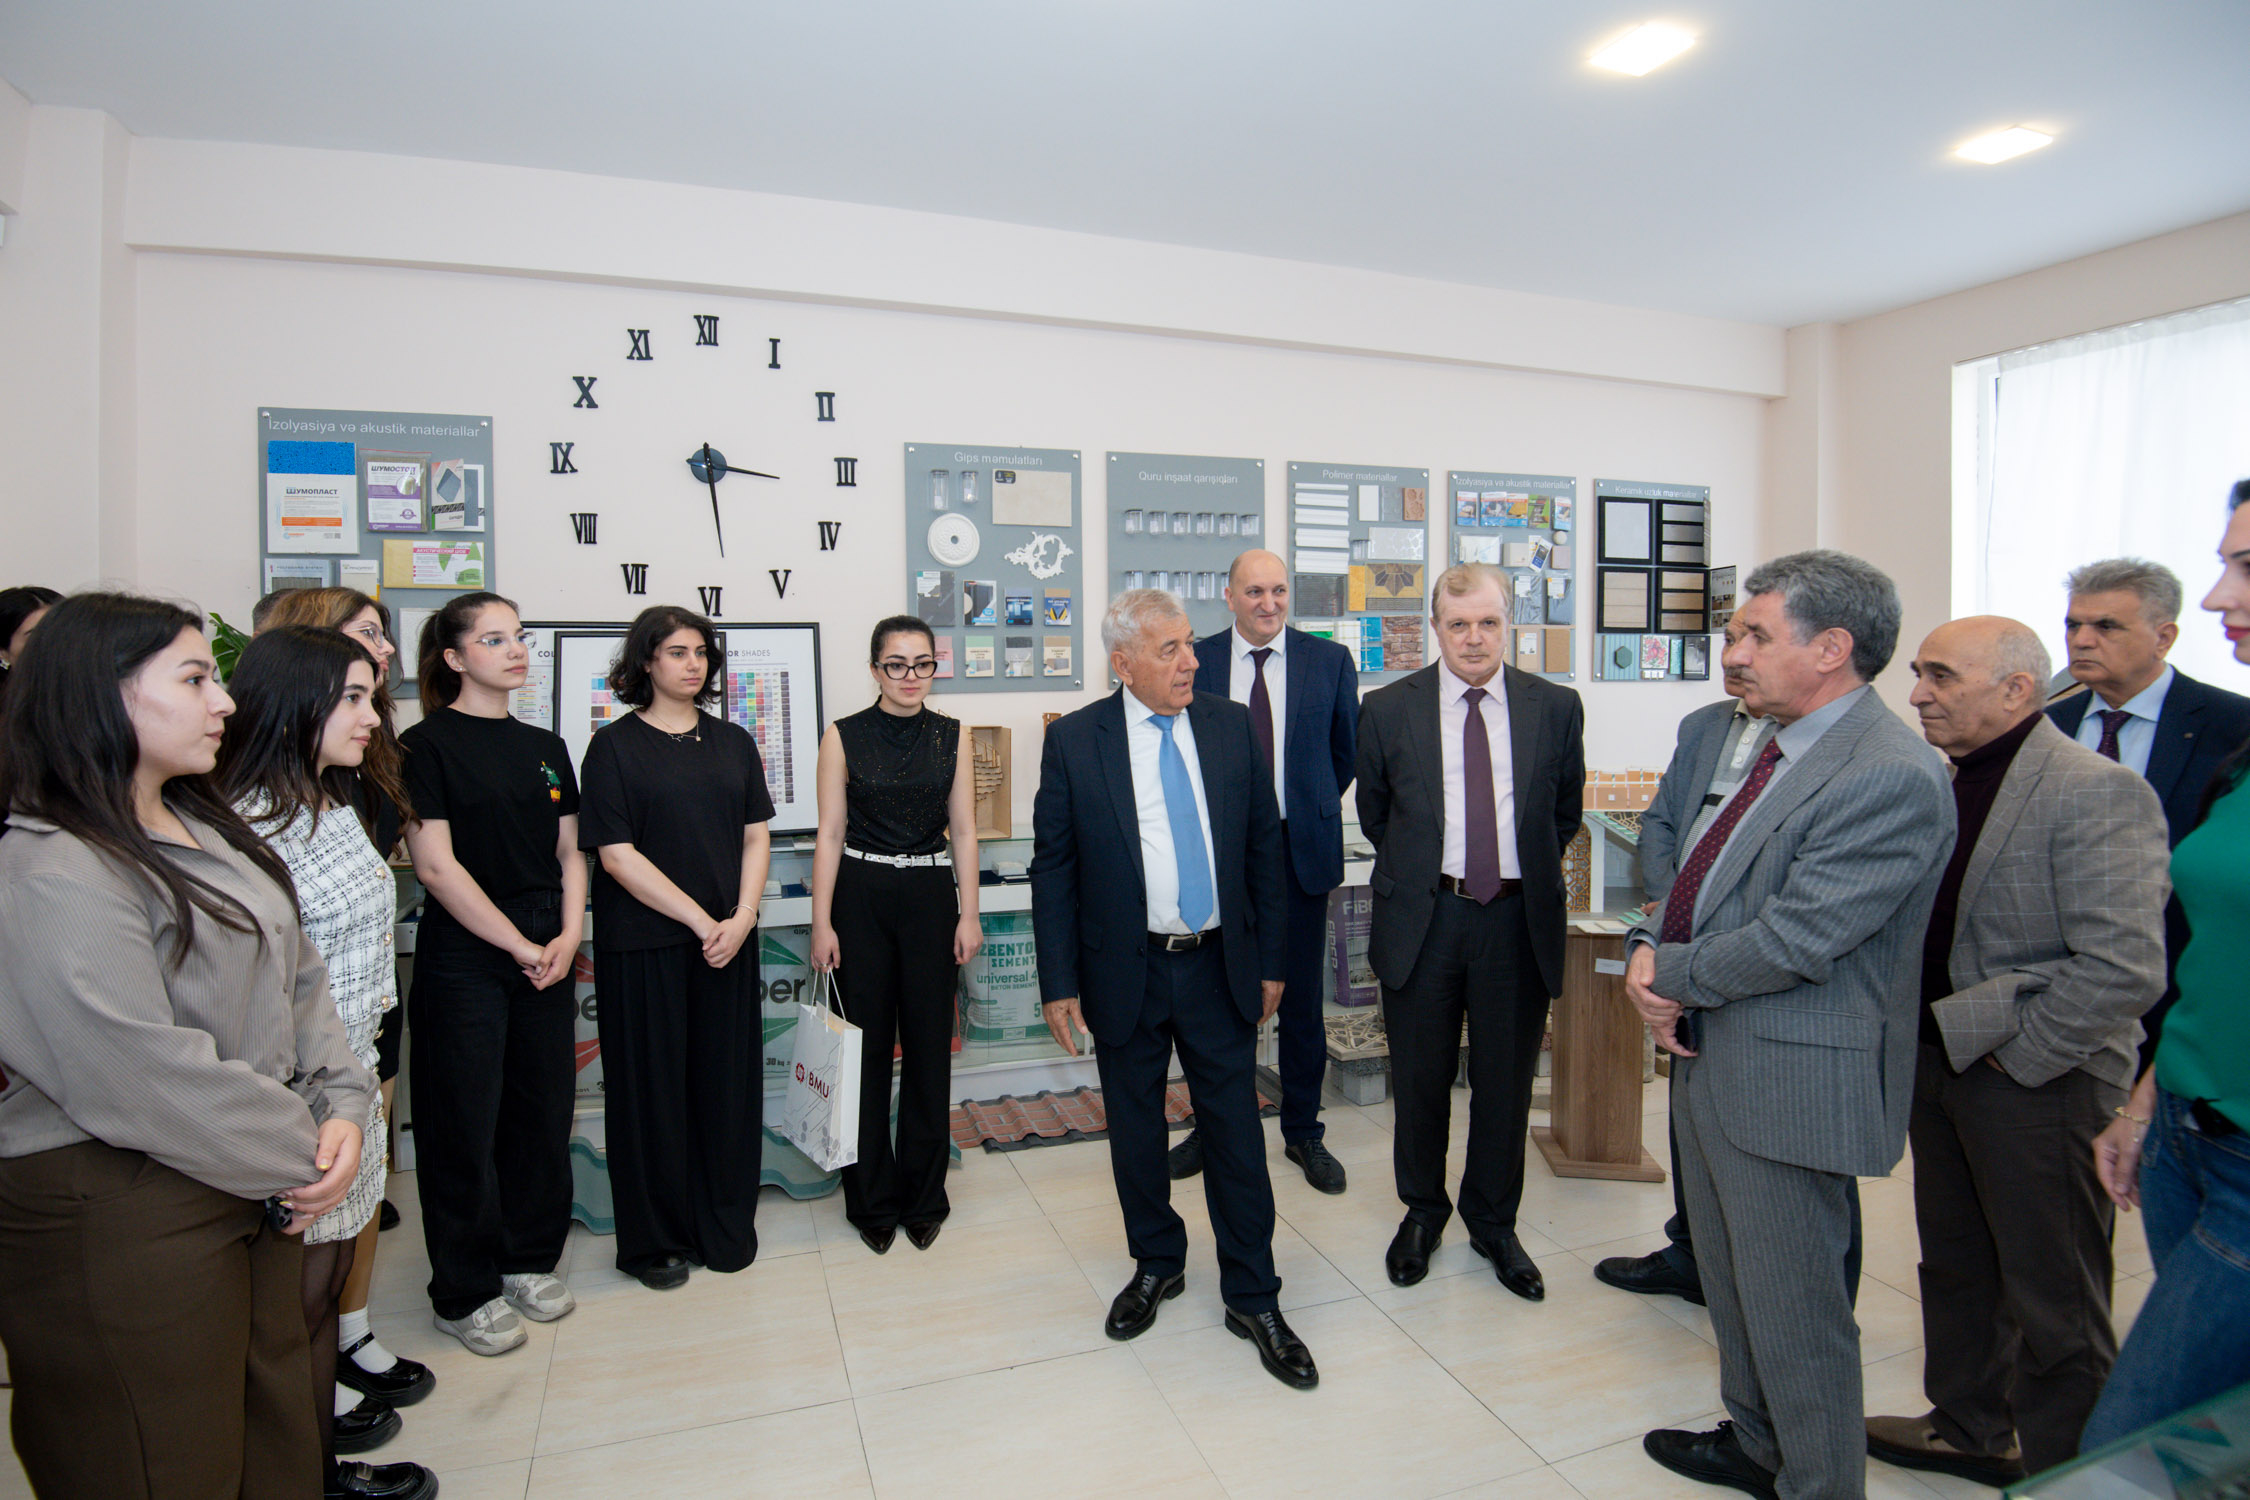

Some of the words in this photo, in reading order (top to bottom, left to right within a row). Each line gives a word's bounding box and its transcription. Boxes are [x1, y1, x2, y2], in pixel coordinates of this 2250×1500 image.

[627, 329, 653, 360] XI
[693, 315, 719, 346] XII
[768, 338, 781, 369] I
[573, 376, 598, 408] X
[815, 392, 835, 421] II
[340, 423, 356, 433] və
[360, 422, 407, 434] akustik
[411, 425, 480, 437] materiallar
[549, 442, 578, 474] IX
[834, 457, 858, 486] III
[954, 451, 979, 464] Gips
[1138, 471, 1161, 481] Quru
[1322, 469, 1353, 480] Polimer
[1355, 472, 1398, 481] materiallar
[286, 487, 338, 495] ШУМОПЛАСТ
[570, 513, 598, 544] VIII
[818, 521, 841, 551] IV
[621, 563, 648, 594] VII
[769, 570, 791, 599] V
[698, 586, 722, 617] VI
[741, 649, 771, 657] SHADES
[976, 941, 1036, 956] ZBENTO
[977, 970, 1029, 984] universal
[808, 1071, 830, 1098] BMU
